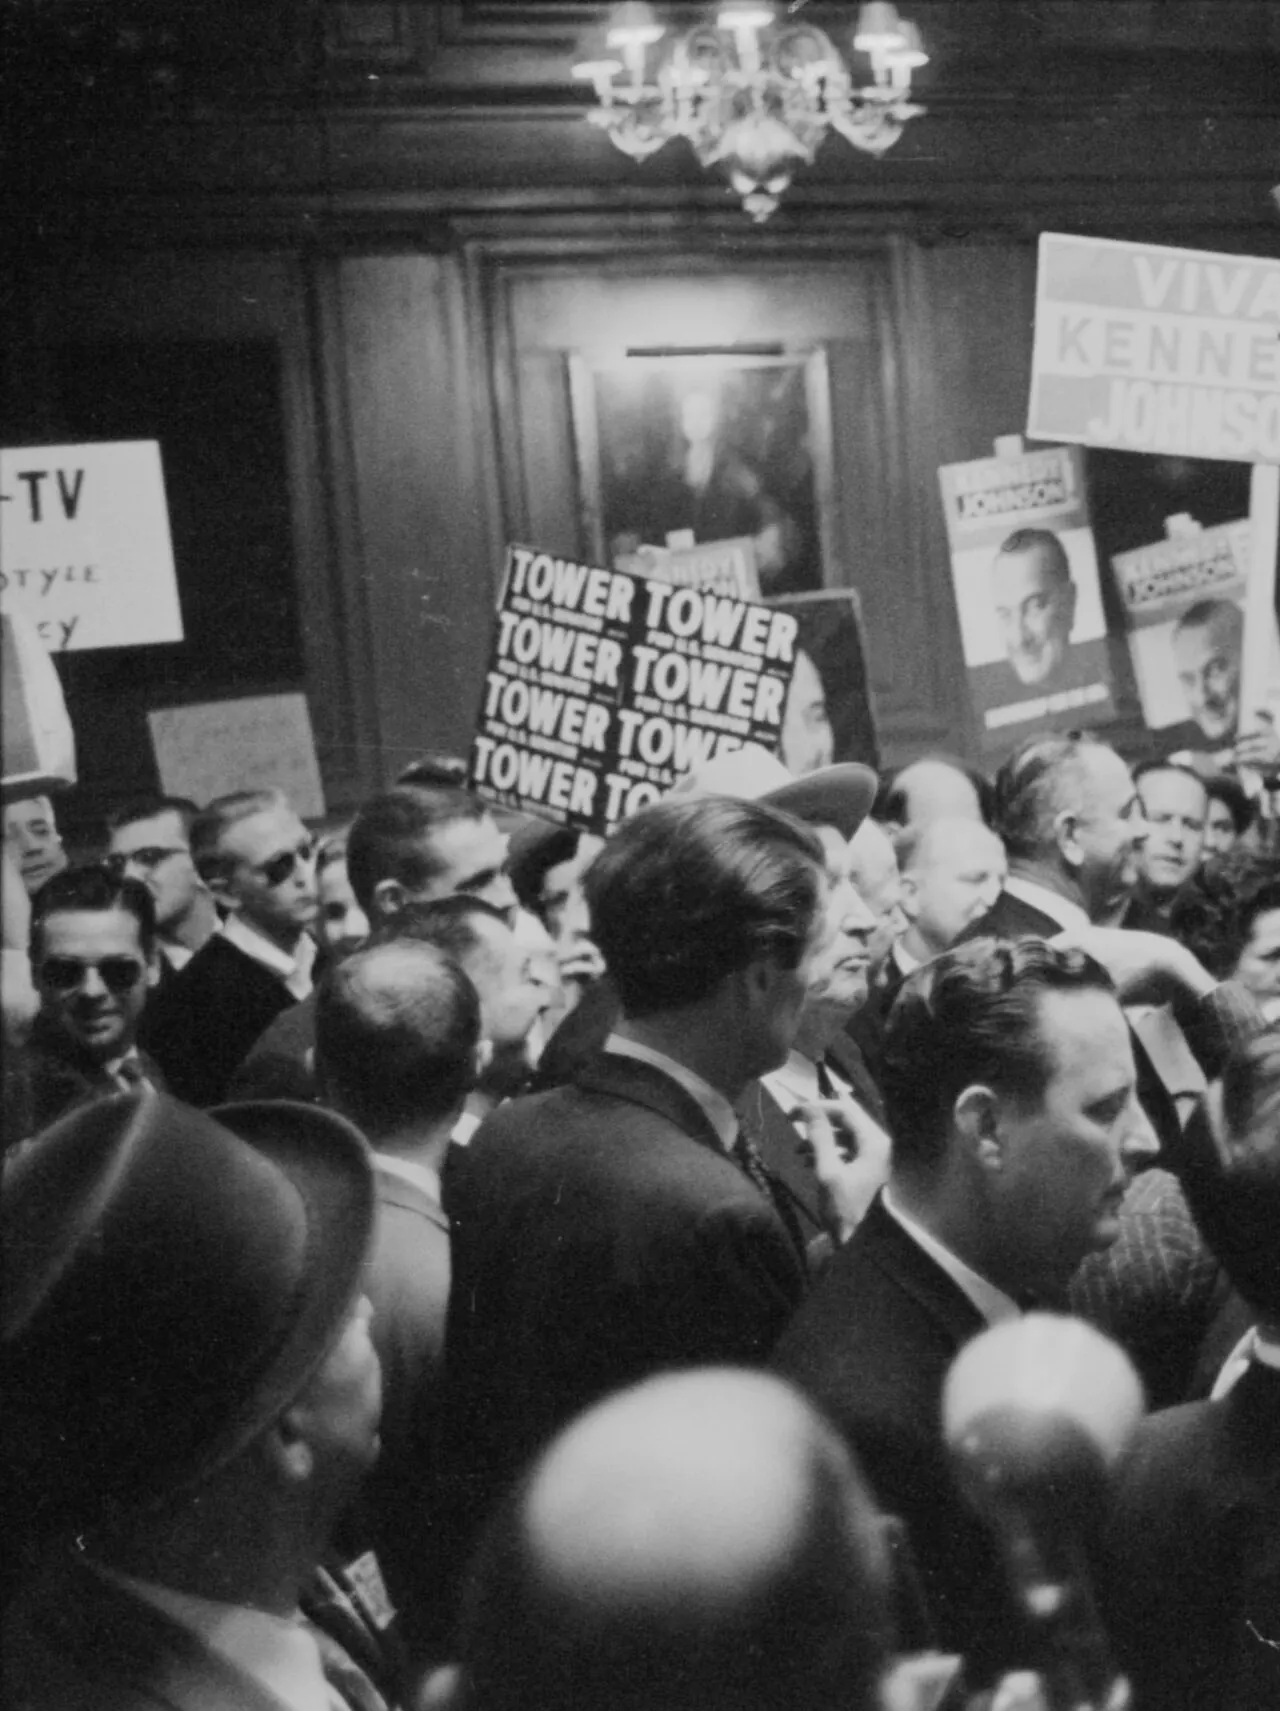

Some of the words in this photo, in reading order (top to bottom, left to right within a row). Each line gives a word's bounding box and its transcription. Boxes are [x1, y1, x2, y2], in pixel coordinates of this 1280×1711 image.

[512, 549, 635, 623] TOWER
[645, 580, 799, 662] TOWER
[486, 672, 610, 752] TOWER
[498, 610, 623, 688] TOWER
[632, 645, 785, 726] TOWER
[474, 736, 598, 817] TOWER
